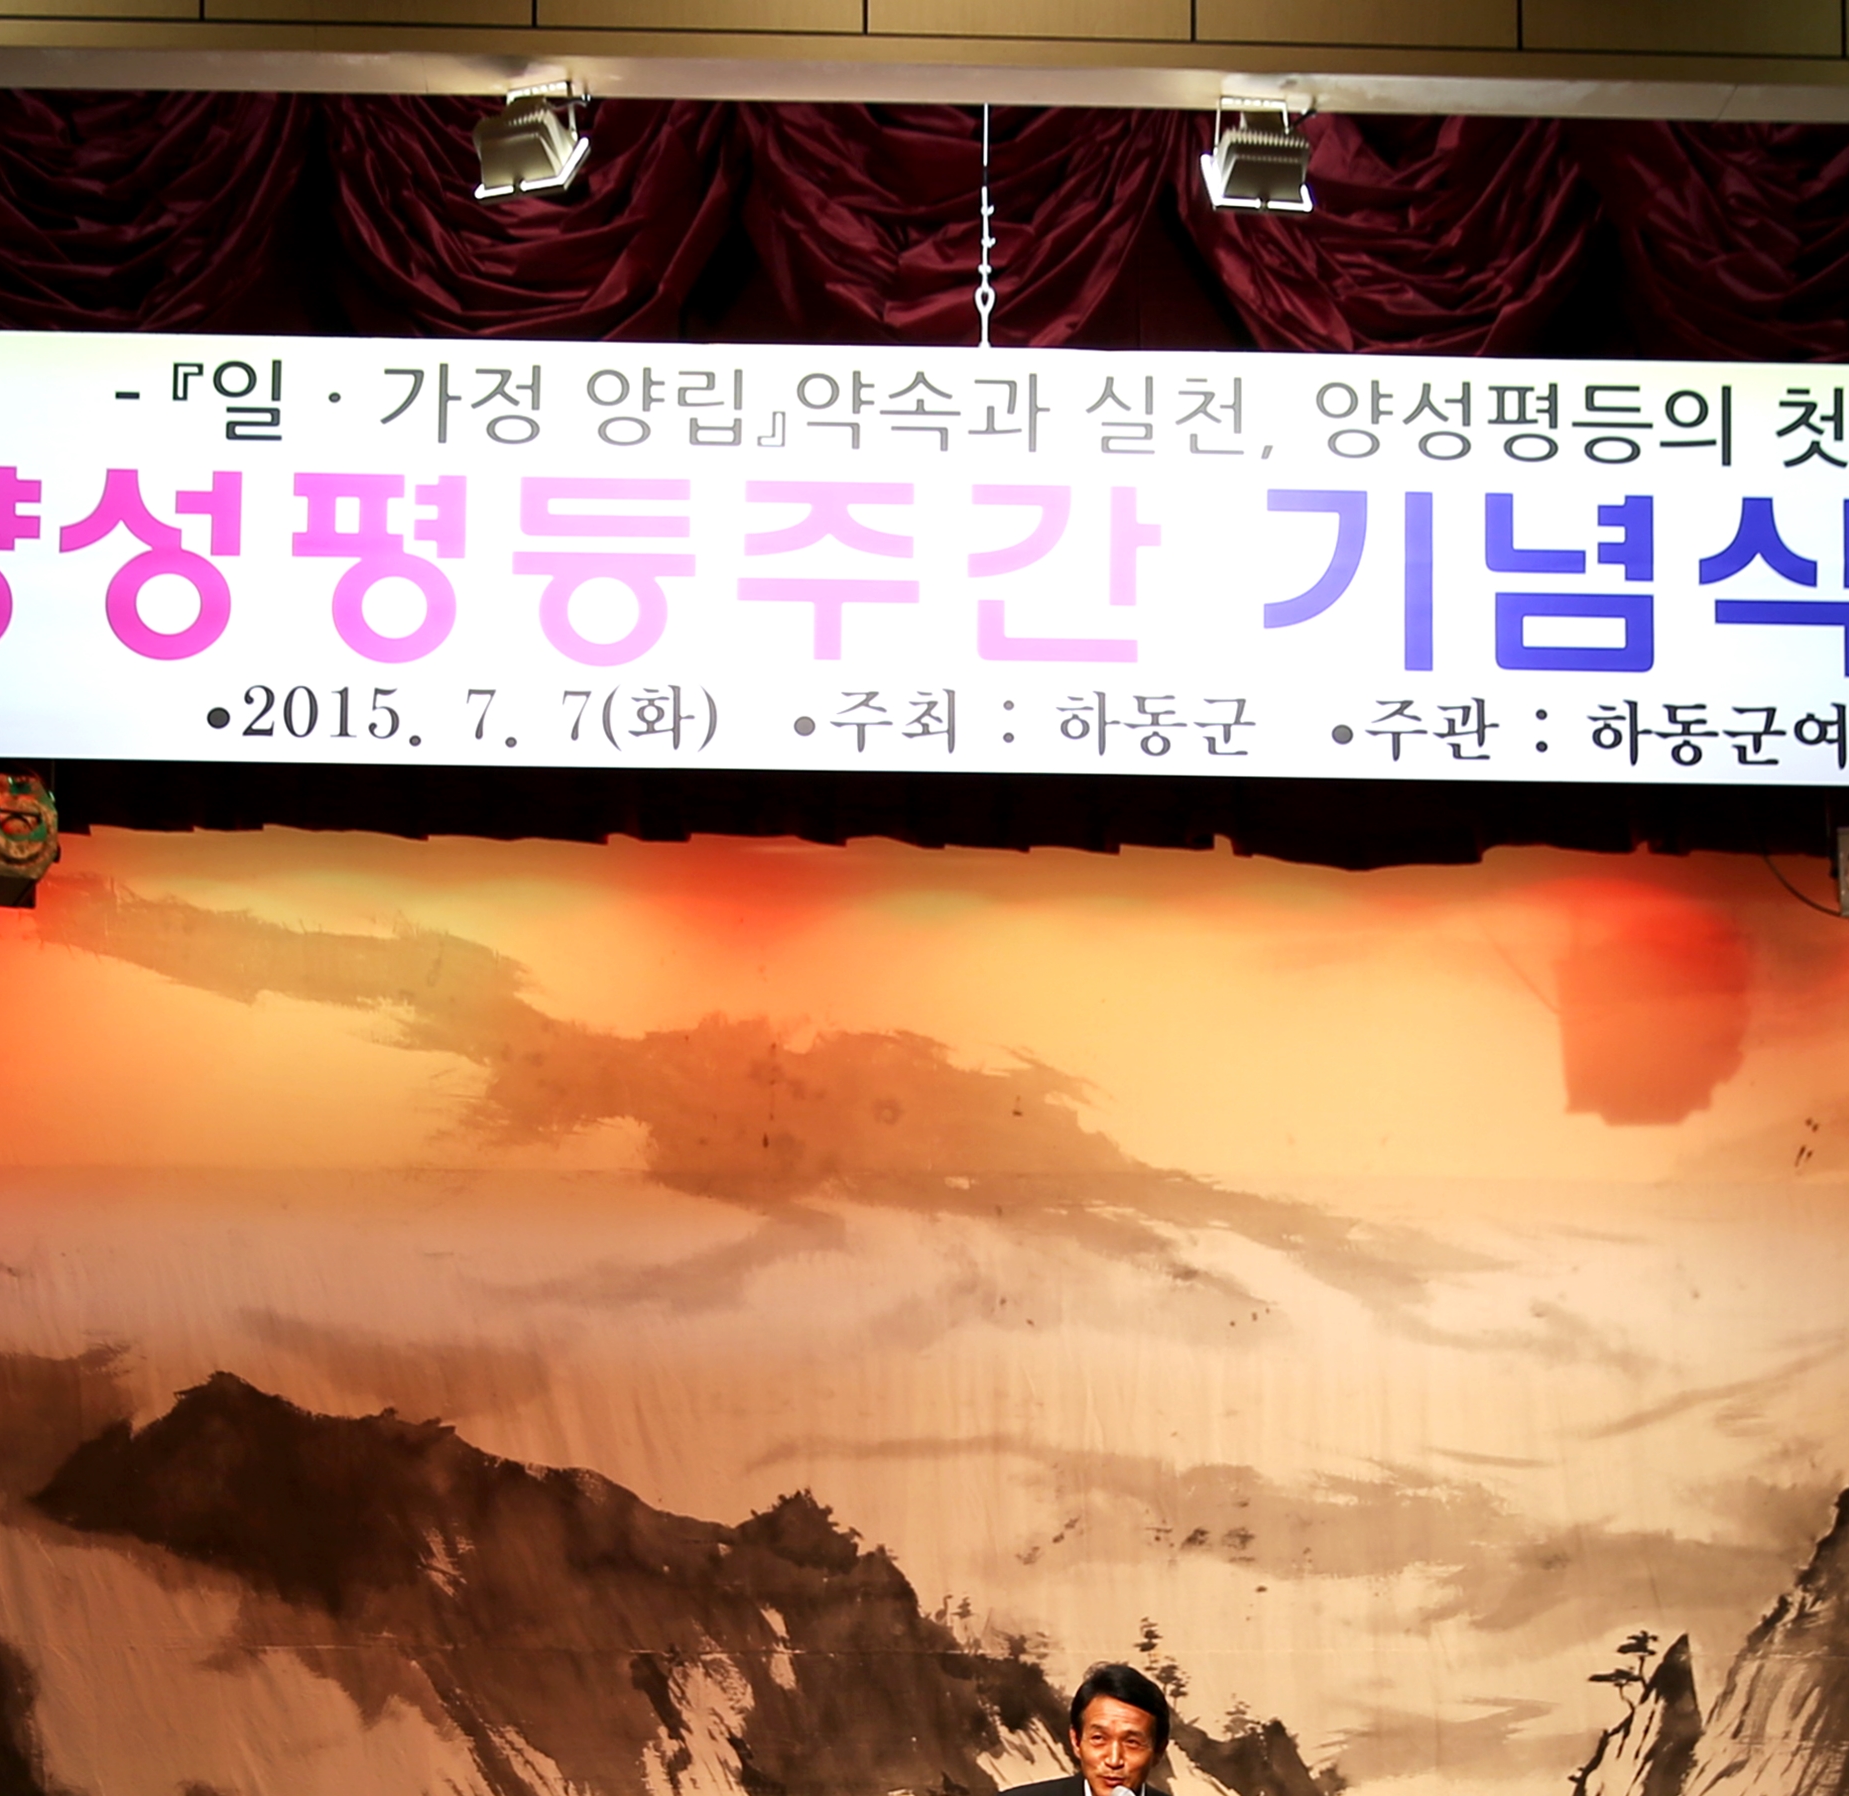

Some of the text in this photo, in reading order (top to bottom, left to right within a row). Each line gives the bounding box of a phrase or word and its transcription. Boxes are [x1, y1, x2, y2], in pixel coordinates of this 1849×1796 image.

[380, 362, 541, 445] 가정
[1085, 375, 1273, 460] 실천,
[1316, 380, 1732, 467] 양성평등의
[1775, 386, 1848, 469] 첫
[466, 688, 518, 749] 7.
[562, 684, 718, 751] 7(화)
[1056, 691, 1256, 757] 하동군
